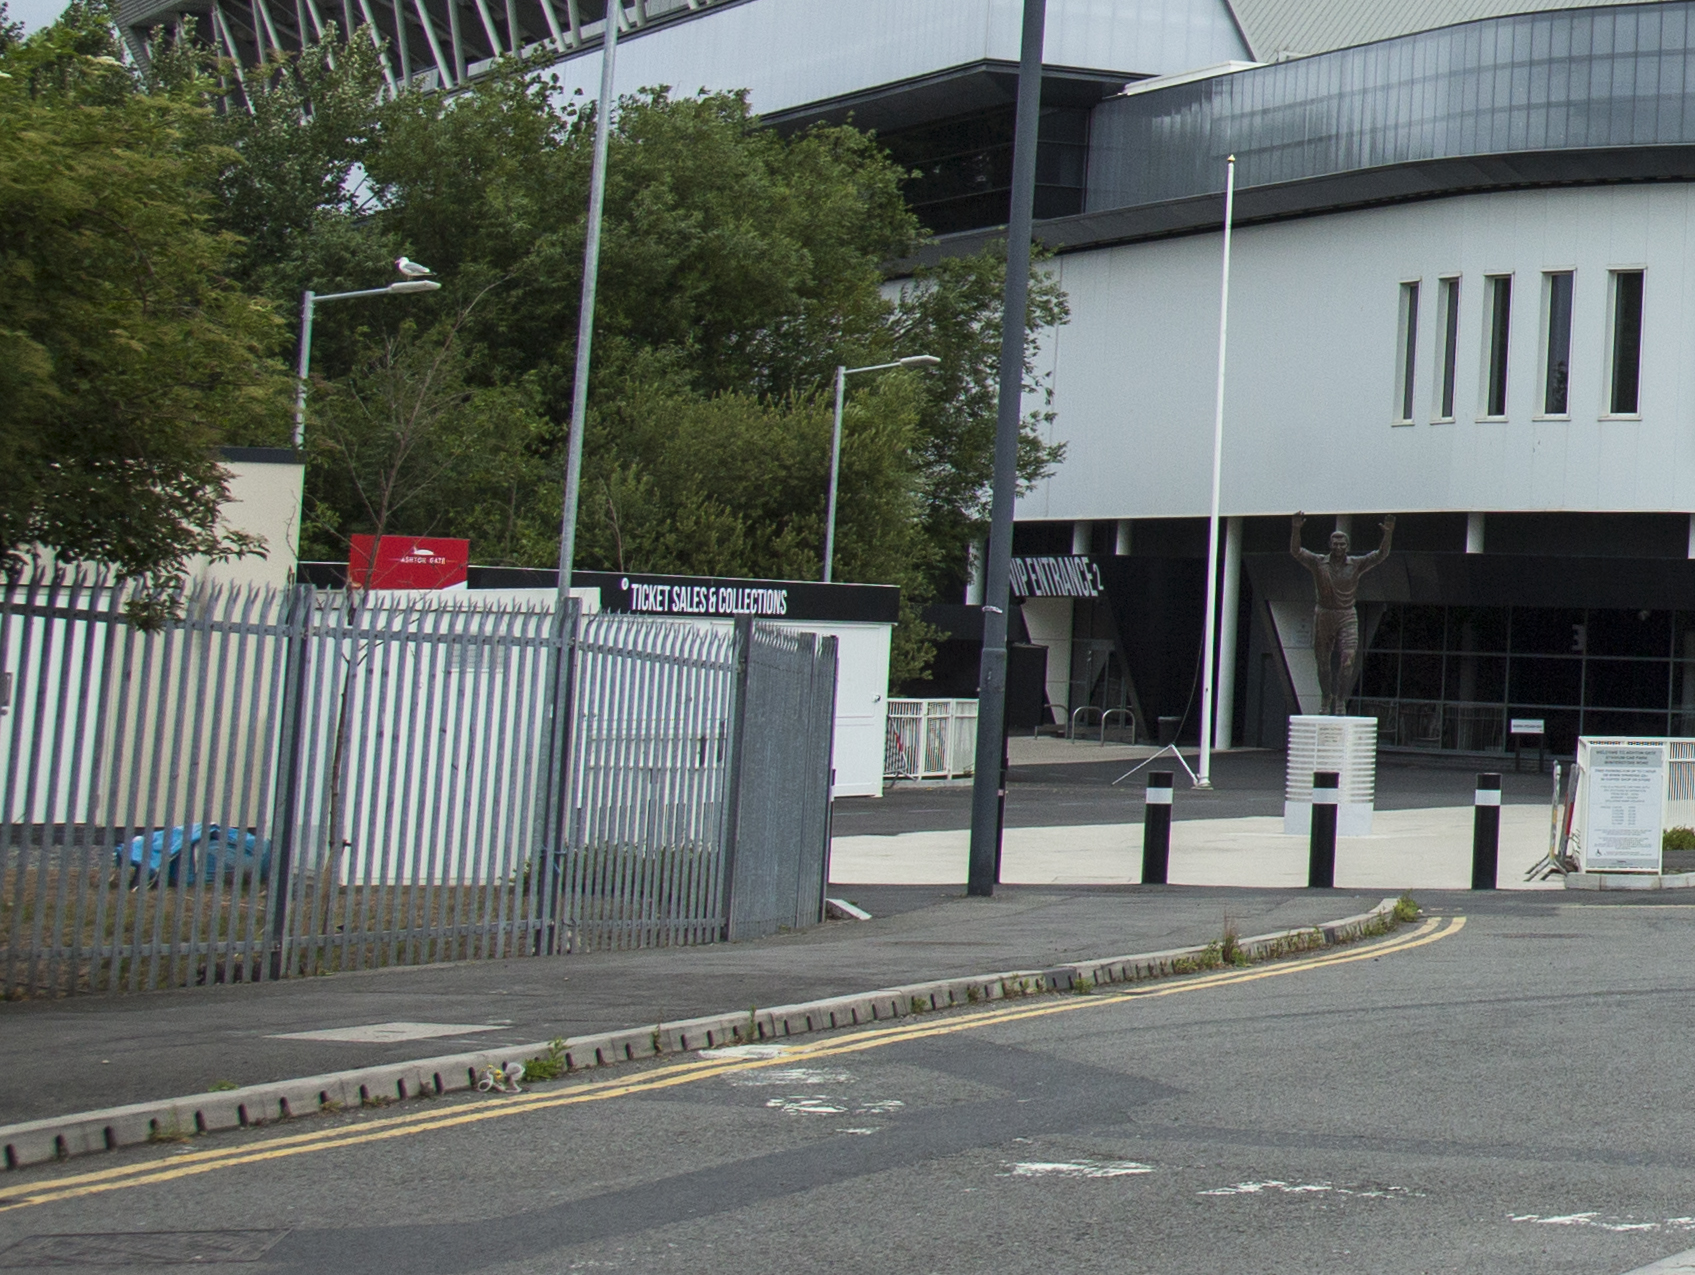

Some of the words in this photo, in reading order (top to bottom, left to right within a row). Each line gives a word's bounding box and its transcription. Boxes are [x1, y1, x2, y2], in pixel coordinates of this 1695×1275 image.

[1025, 556, 1099, 597] ENTRANCE
[631, 583, 671, 612] TICKET
[672, 585, 708, 613] SALES
[708, 587, 717, 613] &
[718, 587, 788, 615] COLLECTIONS
